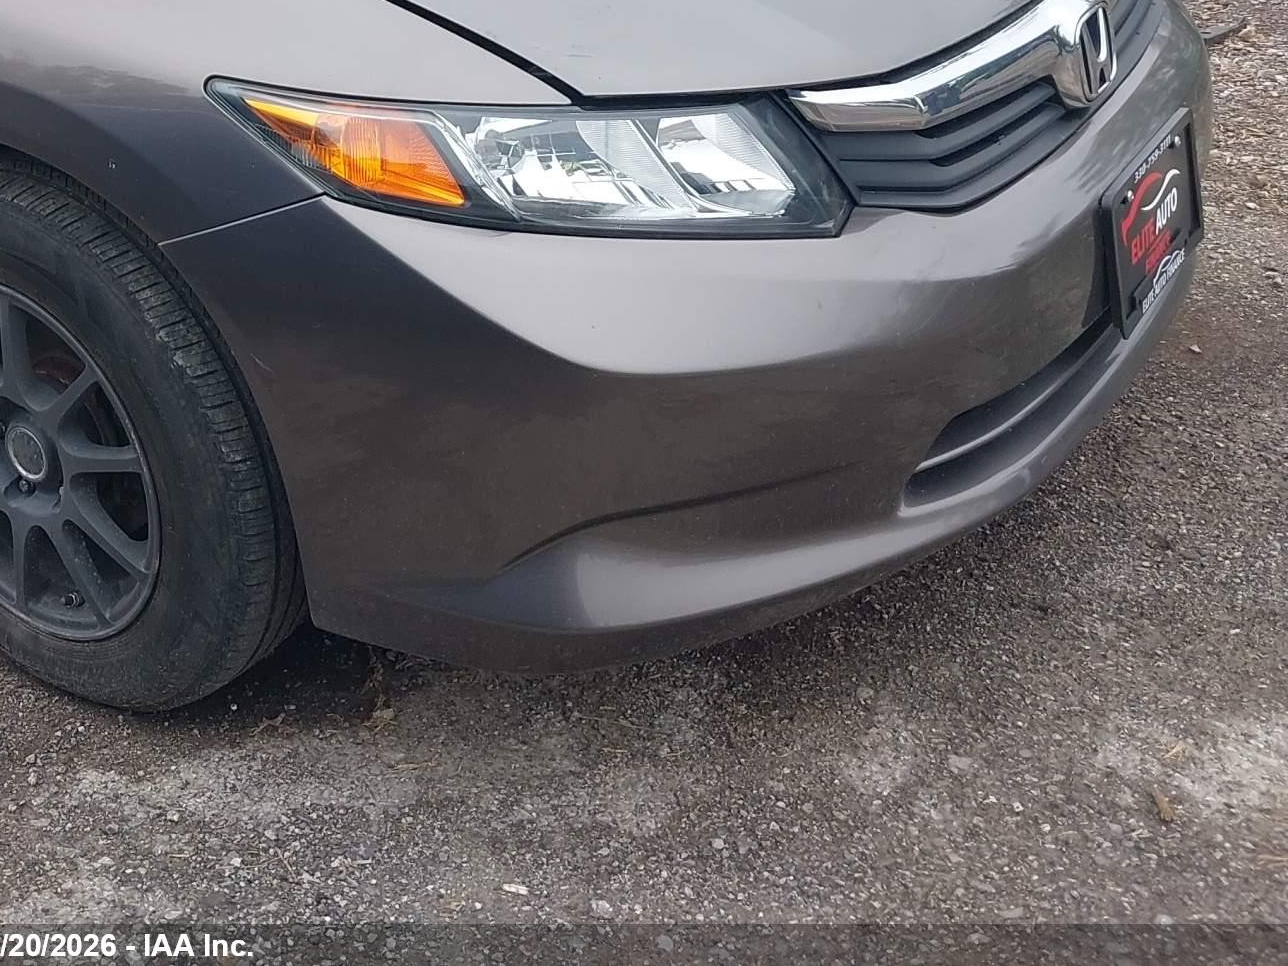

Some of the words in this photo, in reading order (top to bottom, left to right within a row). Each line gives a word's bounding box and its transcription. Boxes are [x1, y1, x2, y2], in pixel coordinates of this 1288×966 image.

[1131, 217, 1156, 266] ELITE
[1155, 187, 1177, 236] AUTO
[1142, 287, 1155, 314] ELITE
[1154, 269, 1167, 297] AUTO
[1166, 247, 1186, 282] FINANCE
